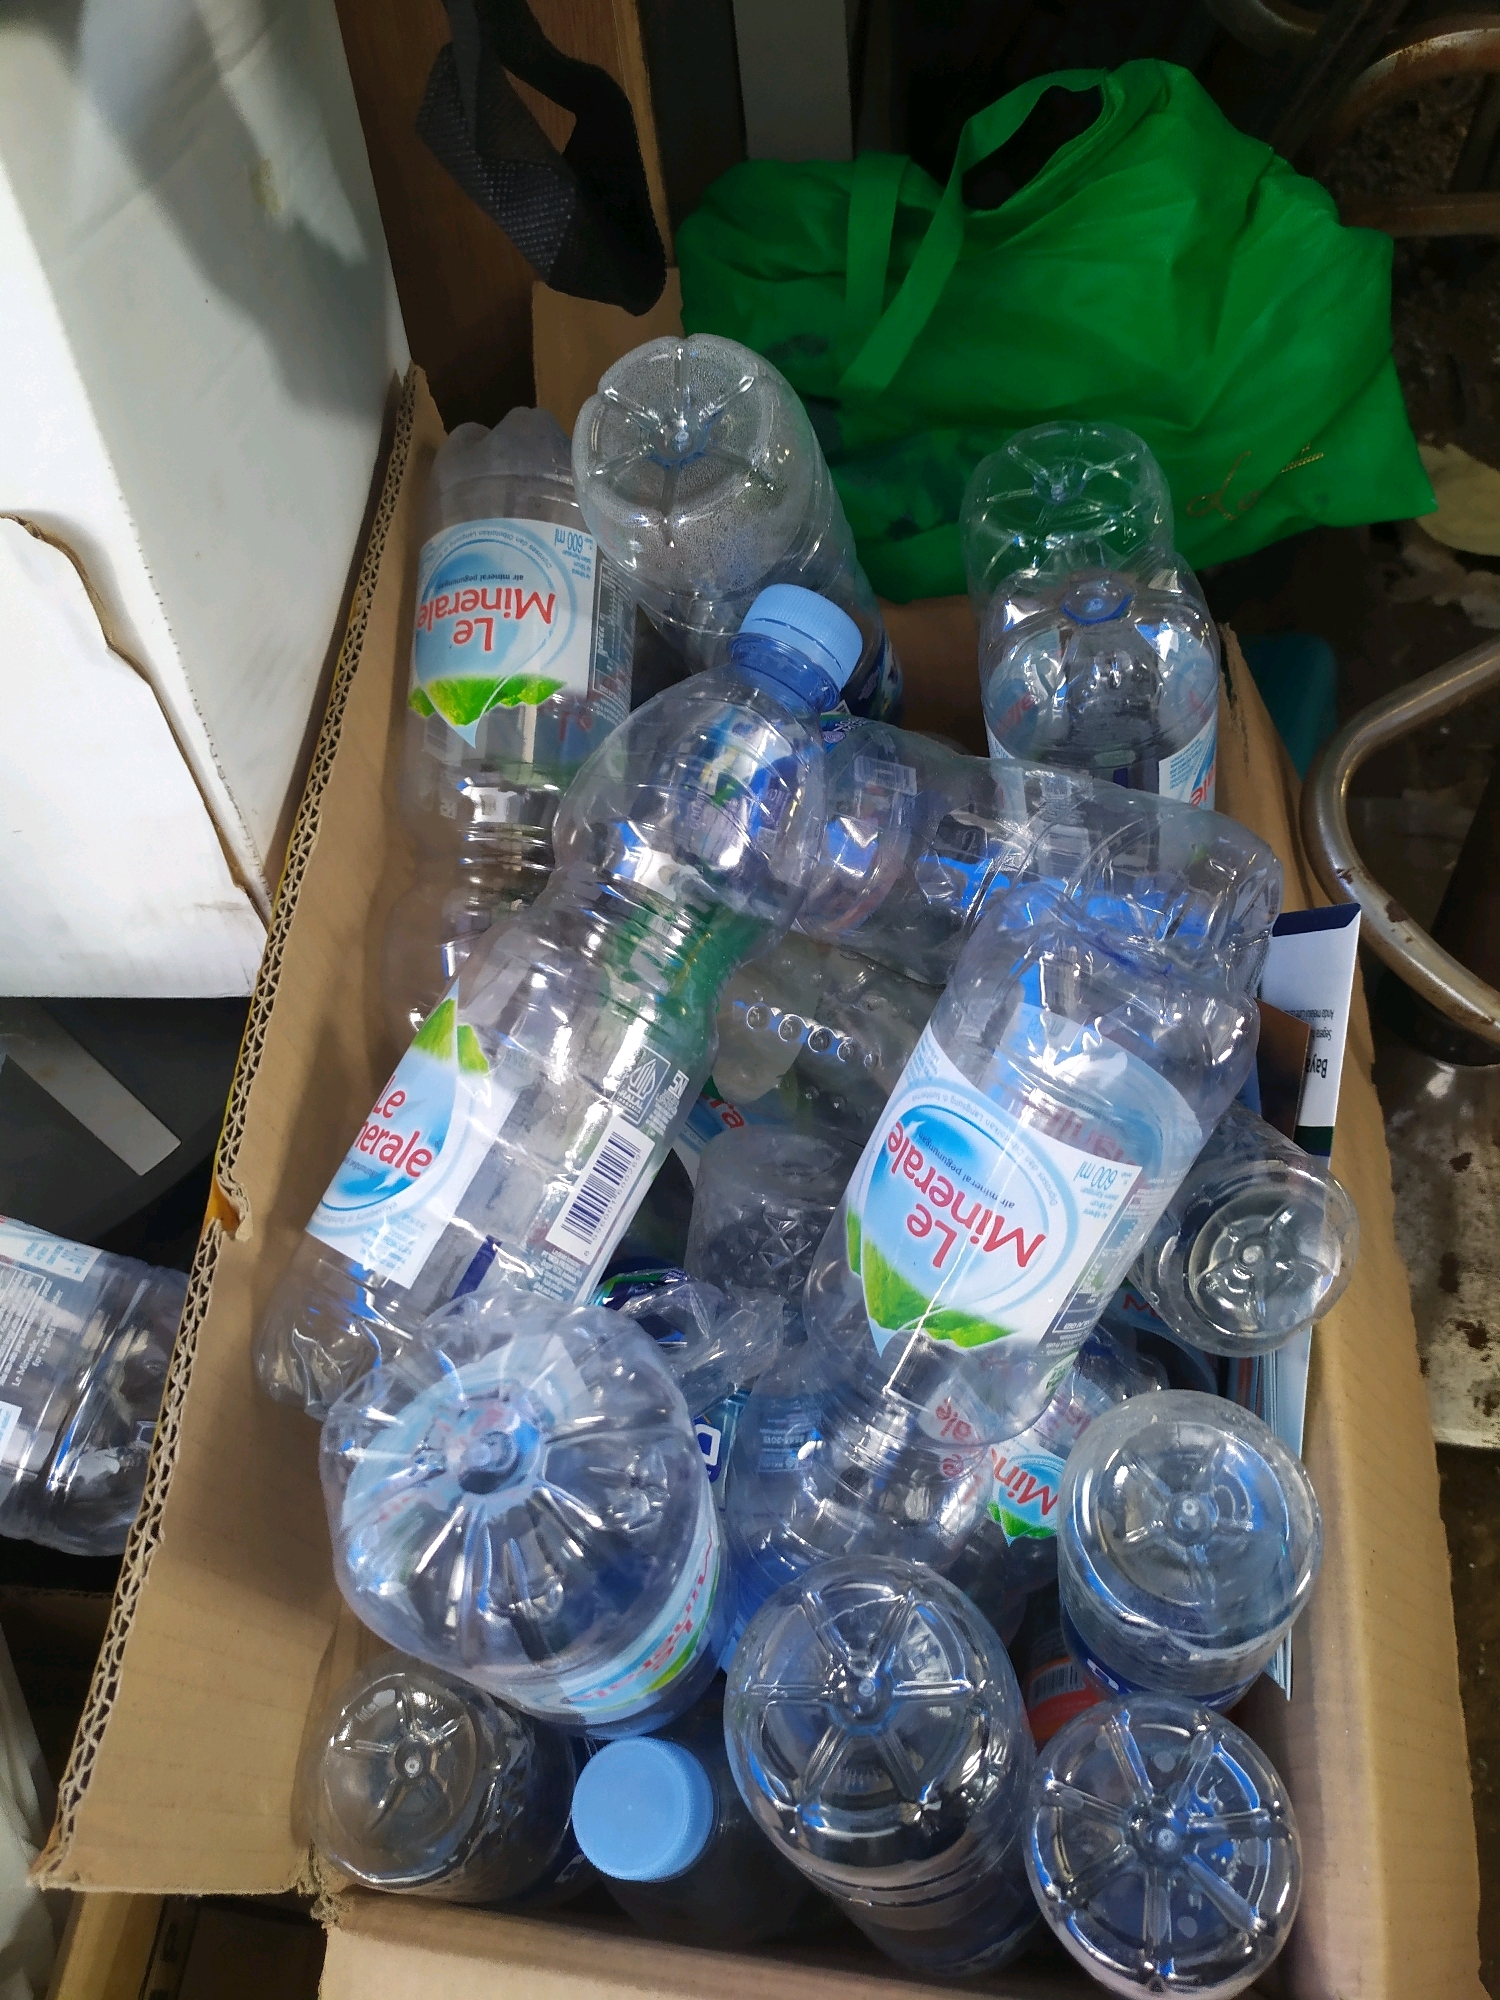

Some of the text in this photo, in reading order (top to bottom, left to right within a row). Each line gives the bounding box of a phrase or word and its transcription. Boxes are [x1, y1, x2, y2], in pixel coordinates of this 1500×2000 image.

[553, 527, 565, 546] ml
[567, 531, 581, 553] 600
[416, 587, 555, 631] Minerale
[452, 616, 493, 651] Le
[1303, 1054, 1328, 1079] Baya
[373, 1074, 406, 1120] Le
[916, 1130, 1015, 1212] air mineral pegunungan
[1073, 1161, 1096, 1181] ml
[1091, 1166, 1117, 1190] 600
[883, 1120, 1047, 1269] Minerale
[904, 1204, 959, 1269] Le
